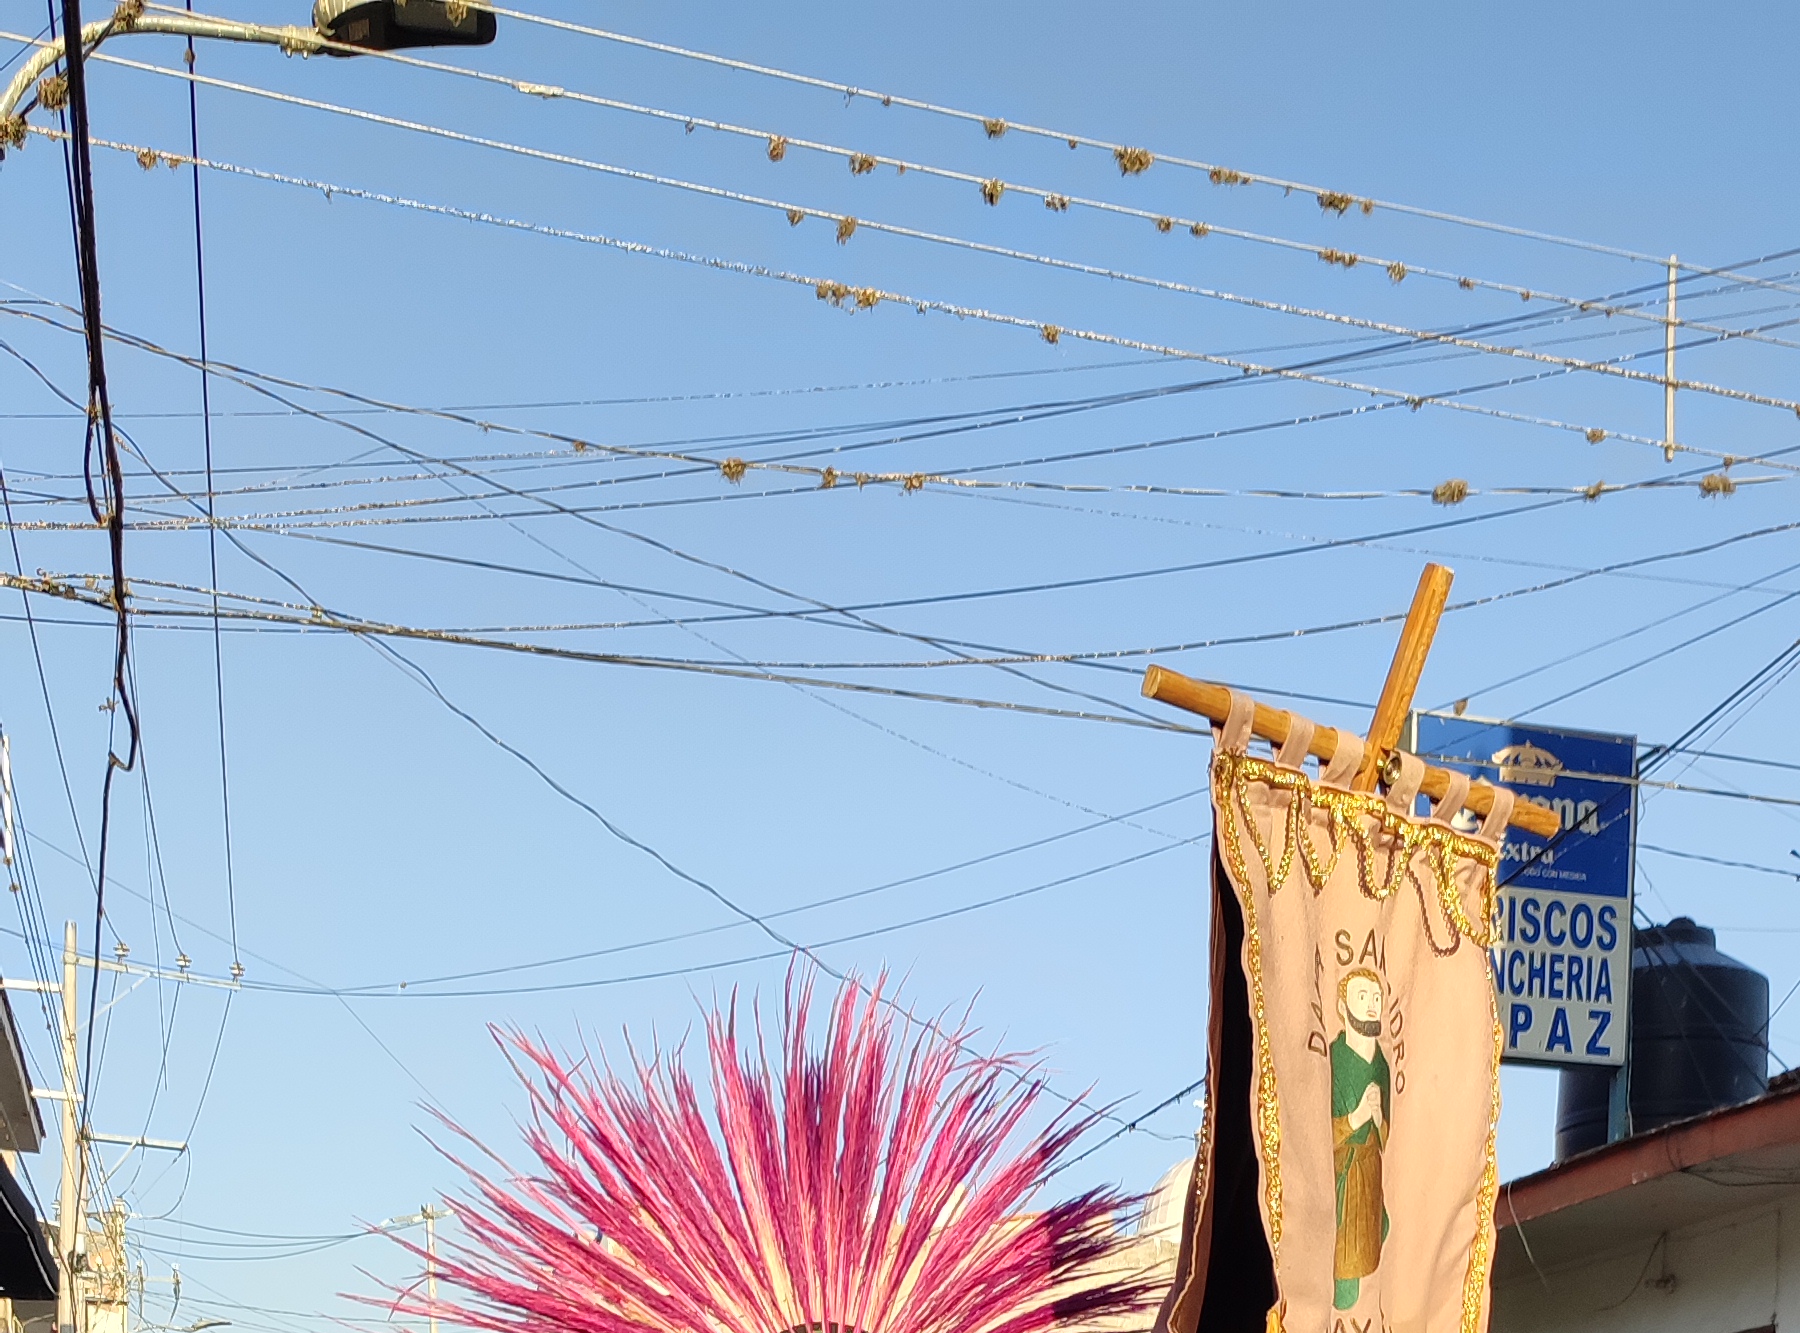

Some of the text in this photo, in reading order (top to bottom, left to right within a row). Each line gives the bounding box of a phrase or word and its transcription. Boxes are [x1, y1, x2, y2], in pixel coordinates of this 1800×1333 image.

[1500, 841, 1554, 864] xtra
[1491, 894, 1618, 951] RISCOS
[1490, 949, 1613, 1004] NCHERIA
[1508, 1003, 1612, 1057] PAZ
